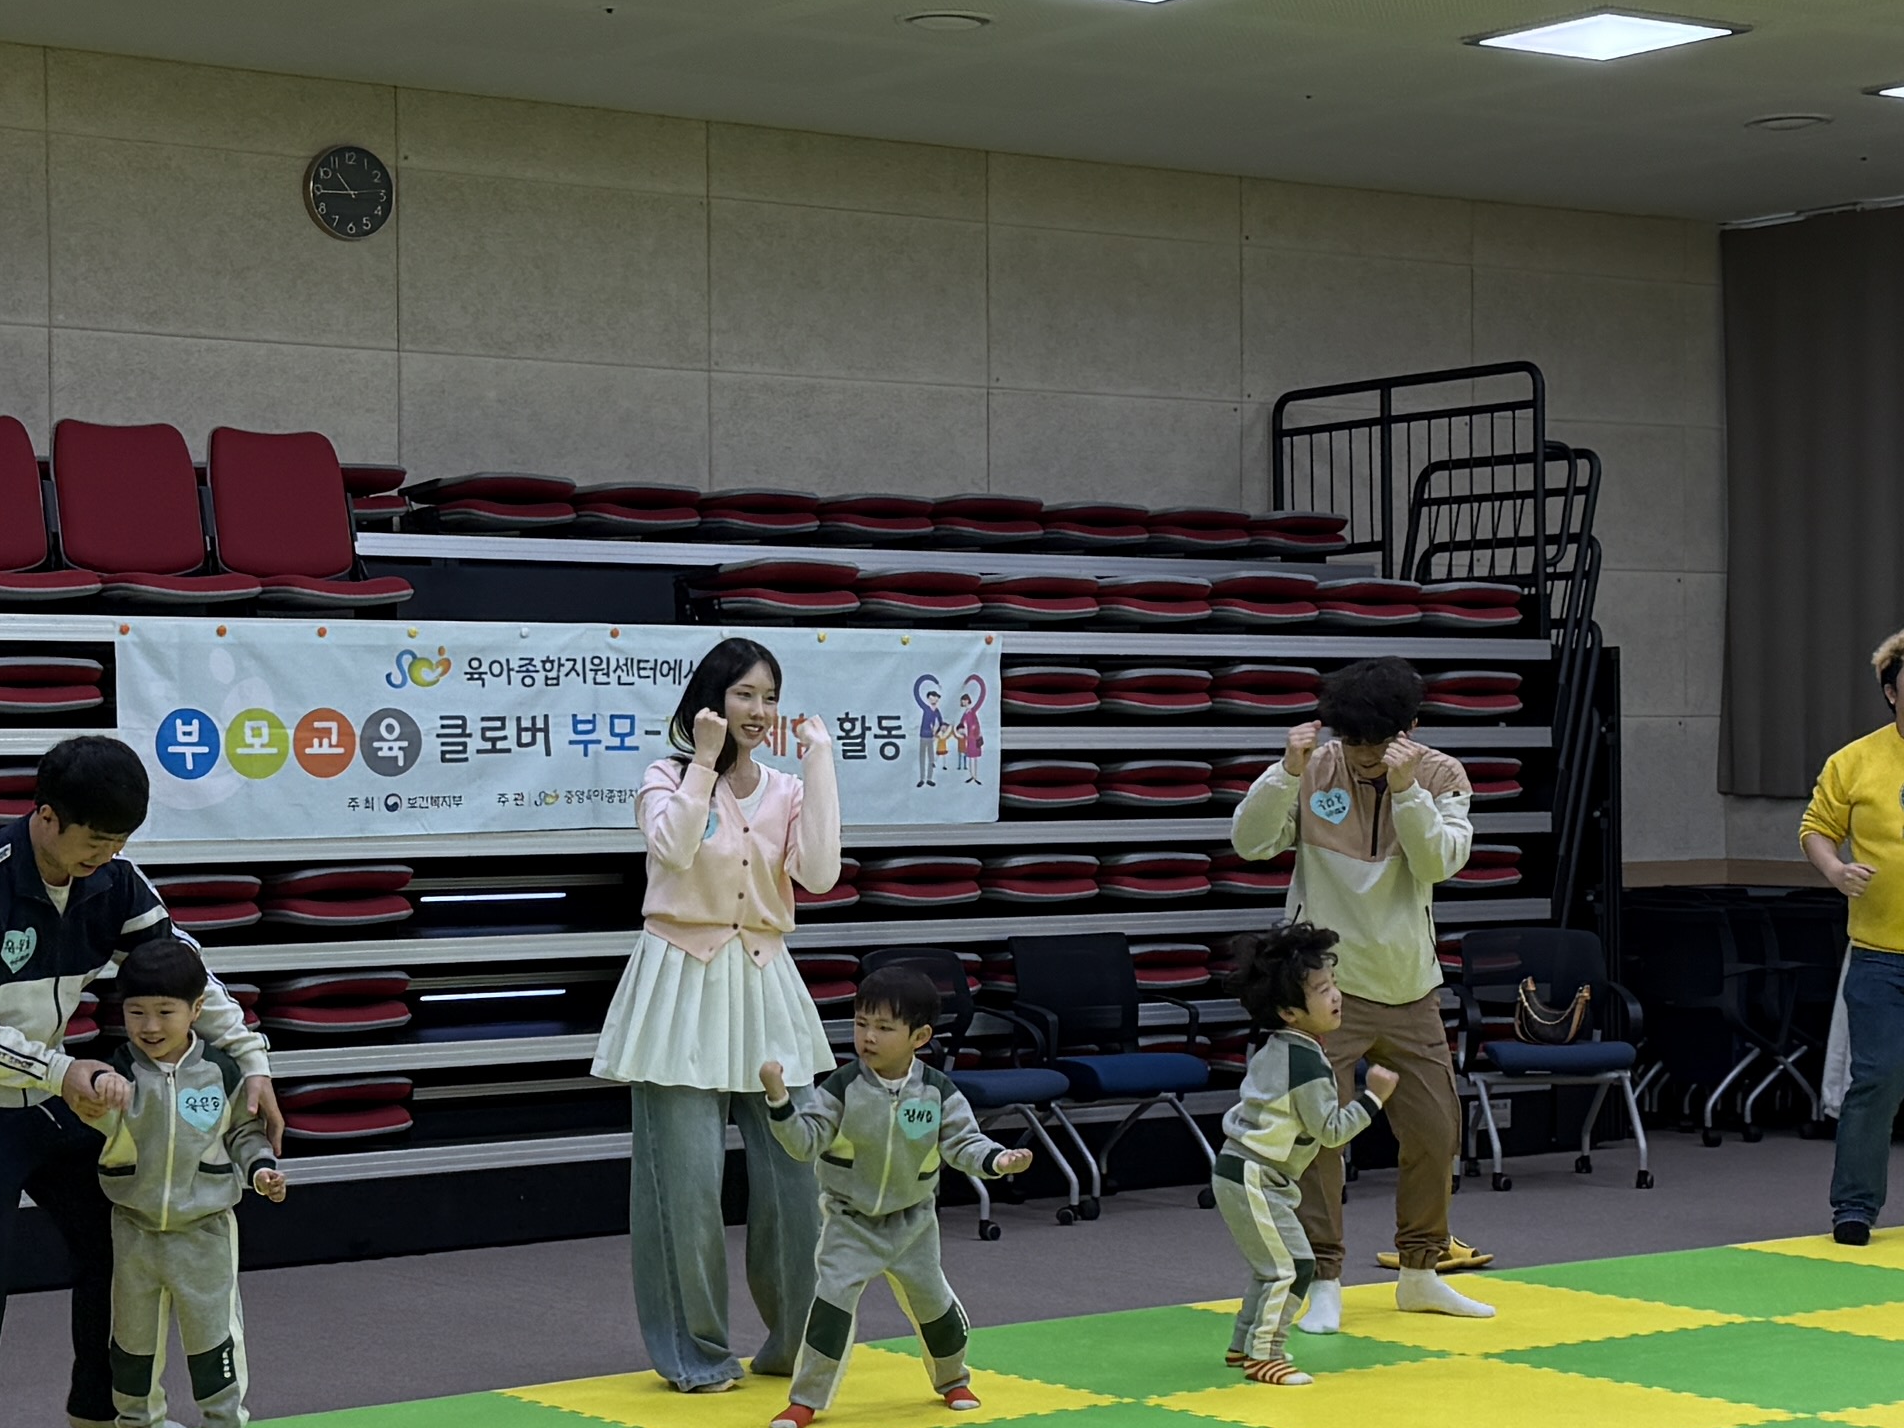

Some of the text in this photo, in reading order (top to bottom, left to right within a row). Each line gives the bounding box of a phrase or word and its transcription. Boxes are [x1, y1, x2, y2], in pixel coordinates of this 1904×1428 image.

[330, 156, 339, 169] 11
[345, 152, 356, 165] 12
[319, 167, 332, 179] 10
[371, 170, 381, 183] 2
[379, 189, 387, 202] 3
[318, 202, 327, 214] 8
[374, 205, 382, 217] 4
[332, 215, 339, 227] 7
[347, 221, 356, 234] 6
[362, 217, 372, 230] 5
[436, 713, 552, 763] 클로버
[836, 711, 906, 761] 활동
